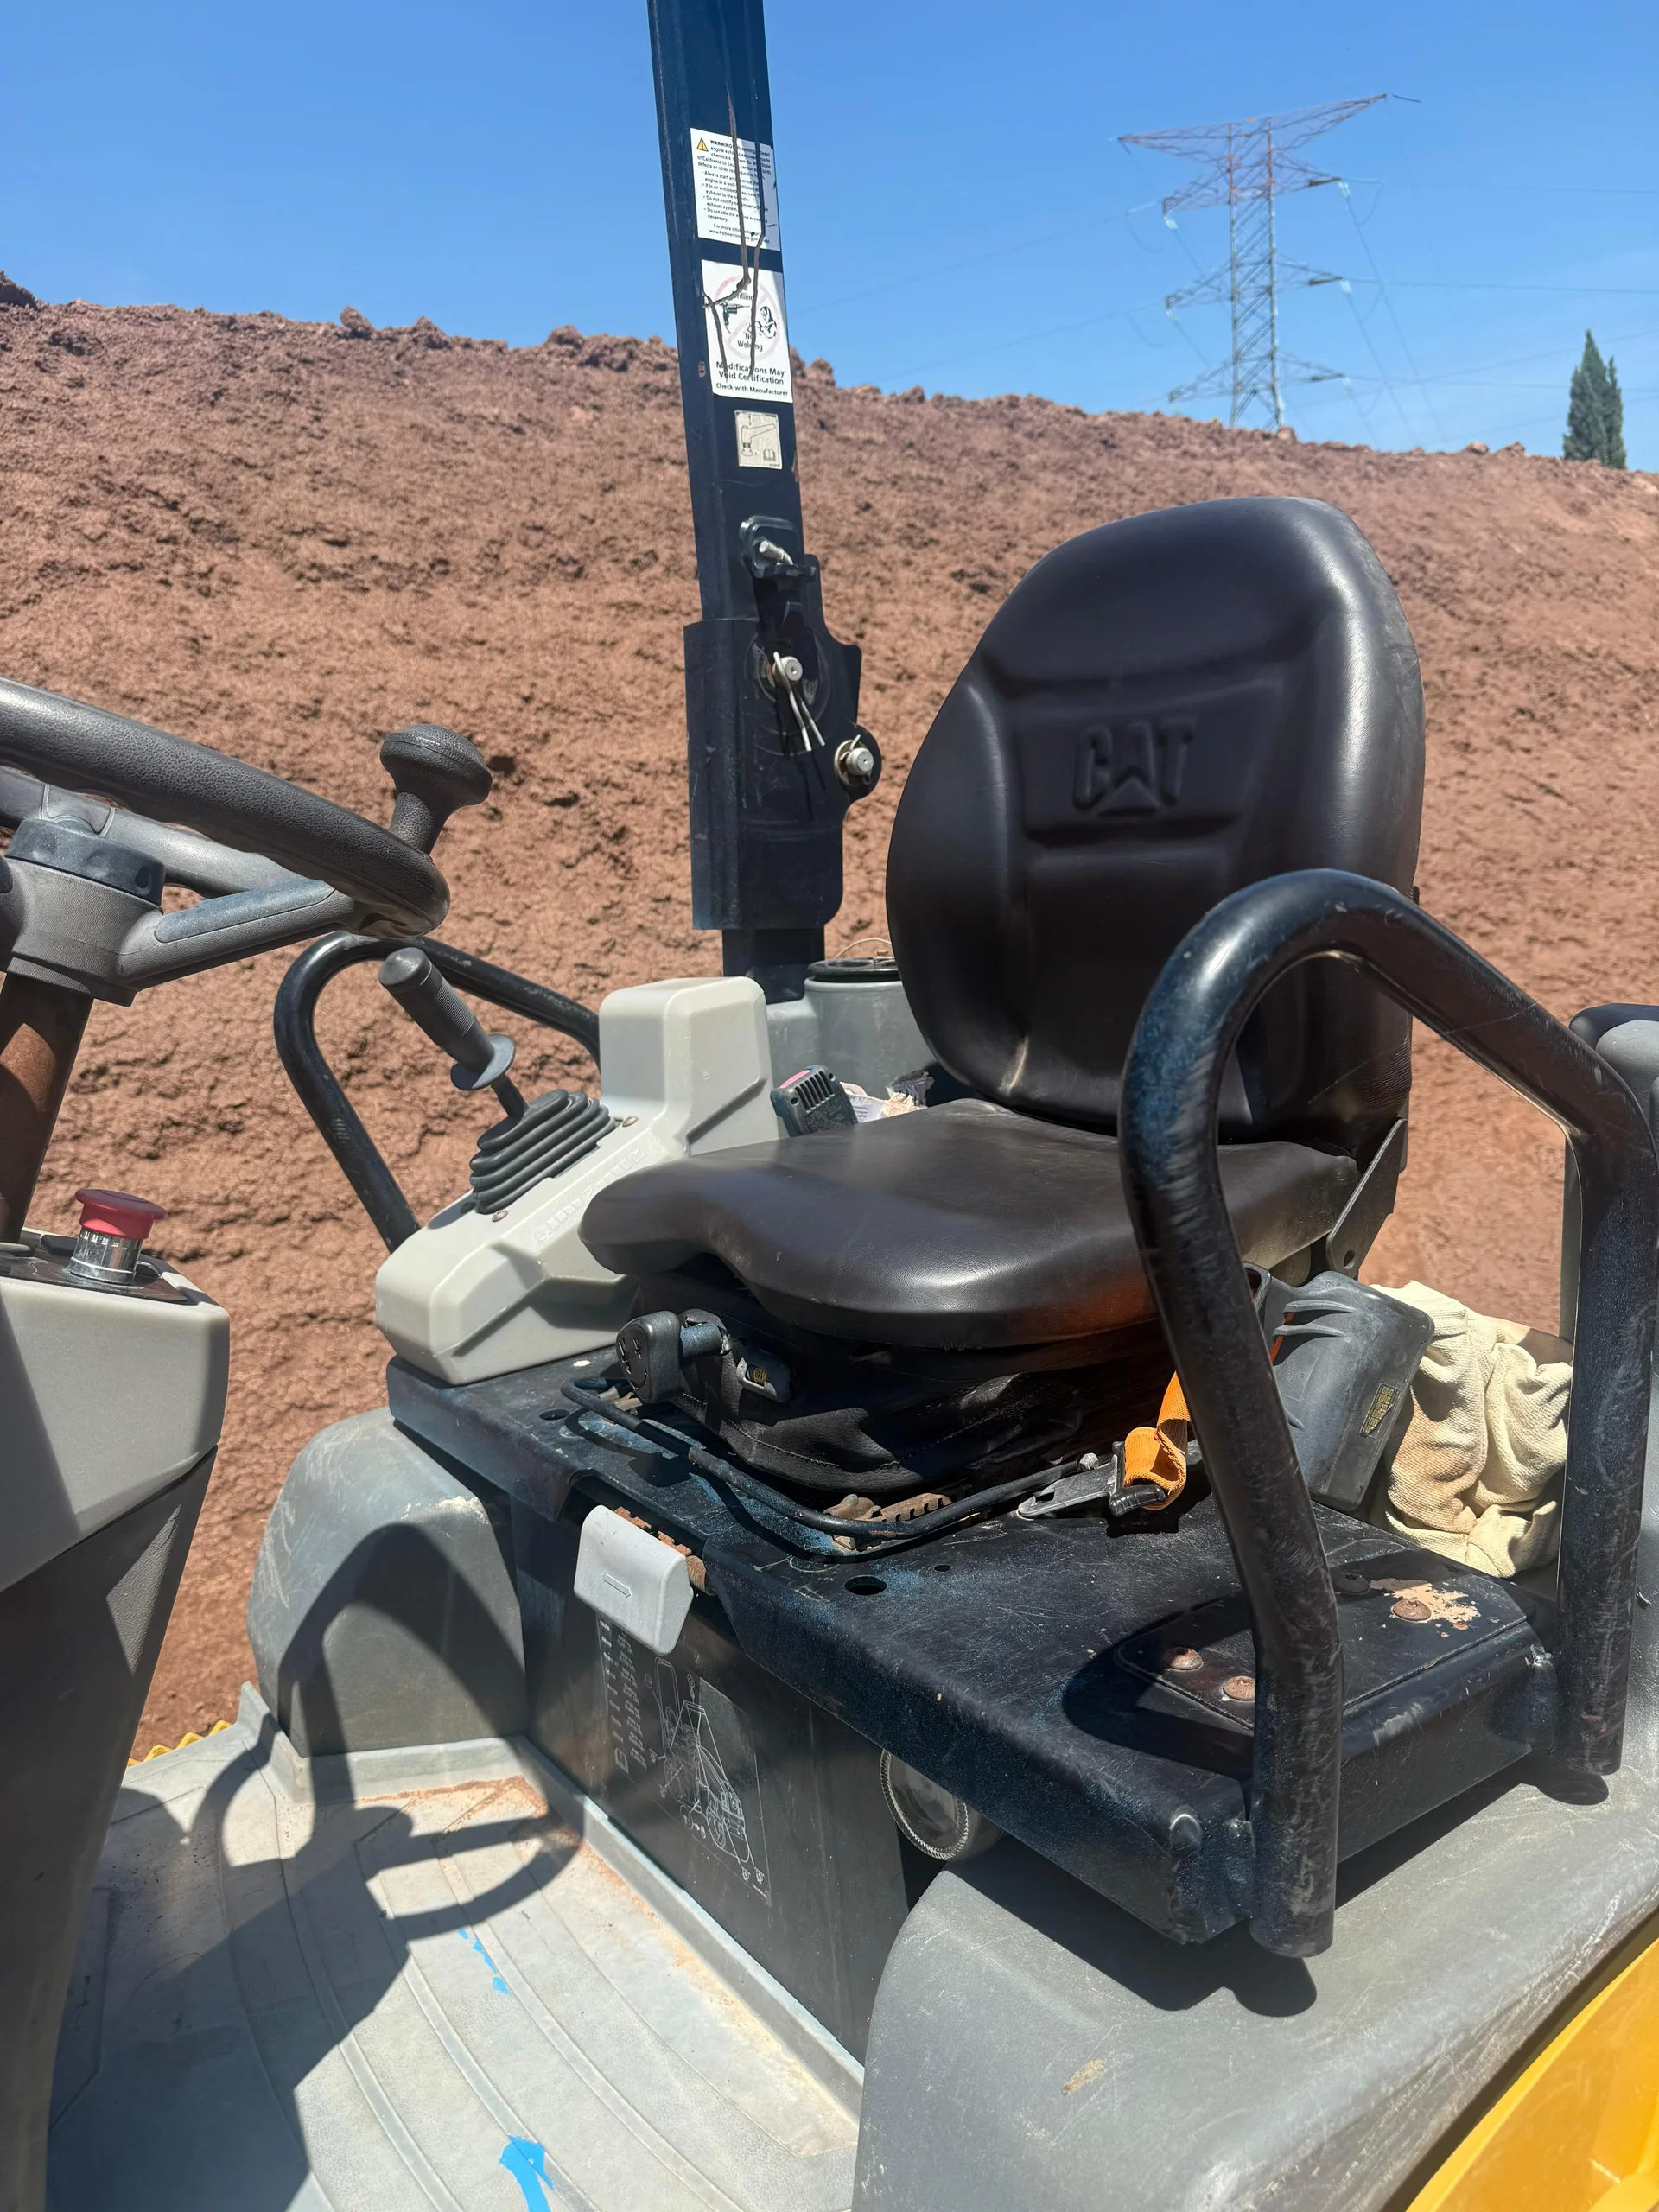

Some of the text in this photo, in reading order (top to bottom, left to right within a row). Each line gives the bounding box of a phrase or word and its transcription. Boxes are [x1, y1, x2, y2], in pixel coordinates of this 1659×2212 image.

[702, 156, 721, 165] California
[737, 340, 763, 353] Welng
[715, 360, 785, 378] Mdificaons May
[738, 372, 785, 385] Certification
[715, 382, 733, 391] Check
[749, 386, 788, 397] Manufacturer
[1072, 715, 1198, 814] CAT
